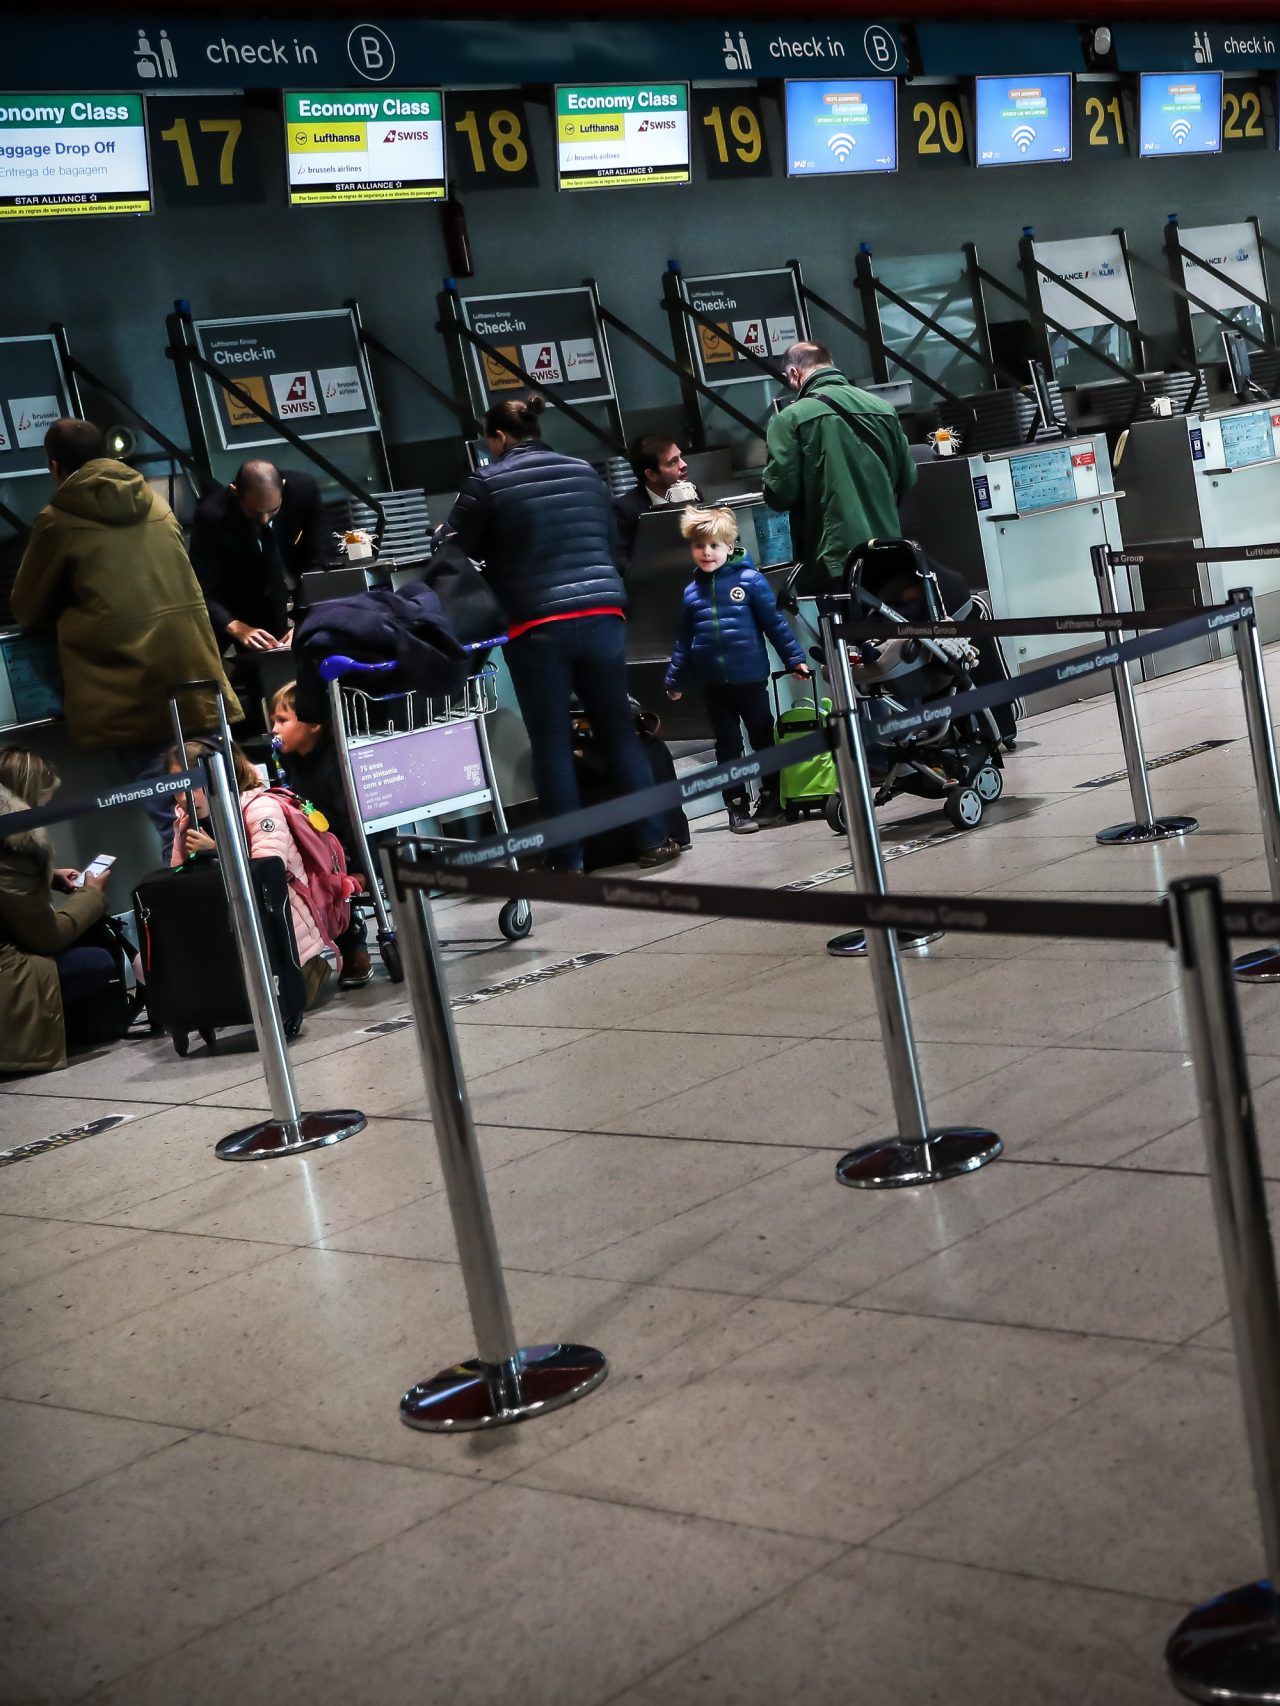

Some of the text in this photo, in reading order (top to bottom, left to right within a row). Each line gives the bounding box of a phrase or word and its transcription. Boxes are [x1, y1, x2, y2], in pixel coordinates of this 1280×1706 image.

[206, 36, 383, 69] check in B
[769, 35, 889, 62] check in B
[1224, 36, 1261, 54] check
[1264, 36, 1275, 54] in
[299, 98, 430, 118] Economy Class
[568, 91, 678, 110] Economy Class
[71, 102, 129, 121] Class
[1223, 93, 1264, 139] 22
[580, 124, 619, 133] Lufthansa
[650, 121, 676, 130] SWISS
[913, 102, 963, 154] 20
[1085, 97, 1125, 145] 21
[314, 134, 360, 143] Lufthansa
[398, 132, 428, 141] SWISS
[455, 110, 527, 172] 18
[704, 106, 762, 163] 19
[55, 142, 90, 156] Drop
[95, 141, 116, 154] Off
[161, 118, 242, 186] 17
[0, 163, 108, 178] Entrega de bagagem
[308, 164, 362, 174] brussels airlines
[357, 182, 393, 190] ALLIANCE
[41, 195, 87, 204] ALLIANCE
[693, 298, 737, 311] Check-in
[475, 319, 526, 335] Check-in
[214, 347, 276, 365] Check-in
[530, 370, 559, 380] SWISS
[337, 380, 358, 395] brussels airlines
[32, 411, 58, 420] brussels
[281, 401, 316, 415] SWISS
[1120, 553, 1144, 564] Group
[1056, 616, 1122, 631] Lufthansa Group
[1207, 611, 1239, 629] Lufthansa
[1056, 651, 1120, 680] Lufthansa Group
[877, 705, 952, 736] Lufthansa Group
[360, 762, 384, 773] 75 anos
[373, 767, 398, 779] sintonia
[363, 782, 377, 790] com
[681, 763, 760, 797] Lufthansa Group
[97, 778, 191, 808] Lufthansa Group
